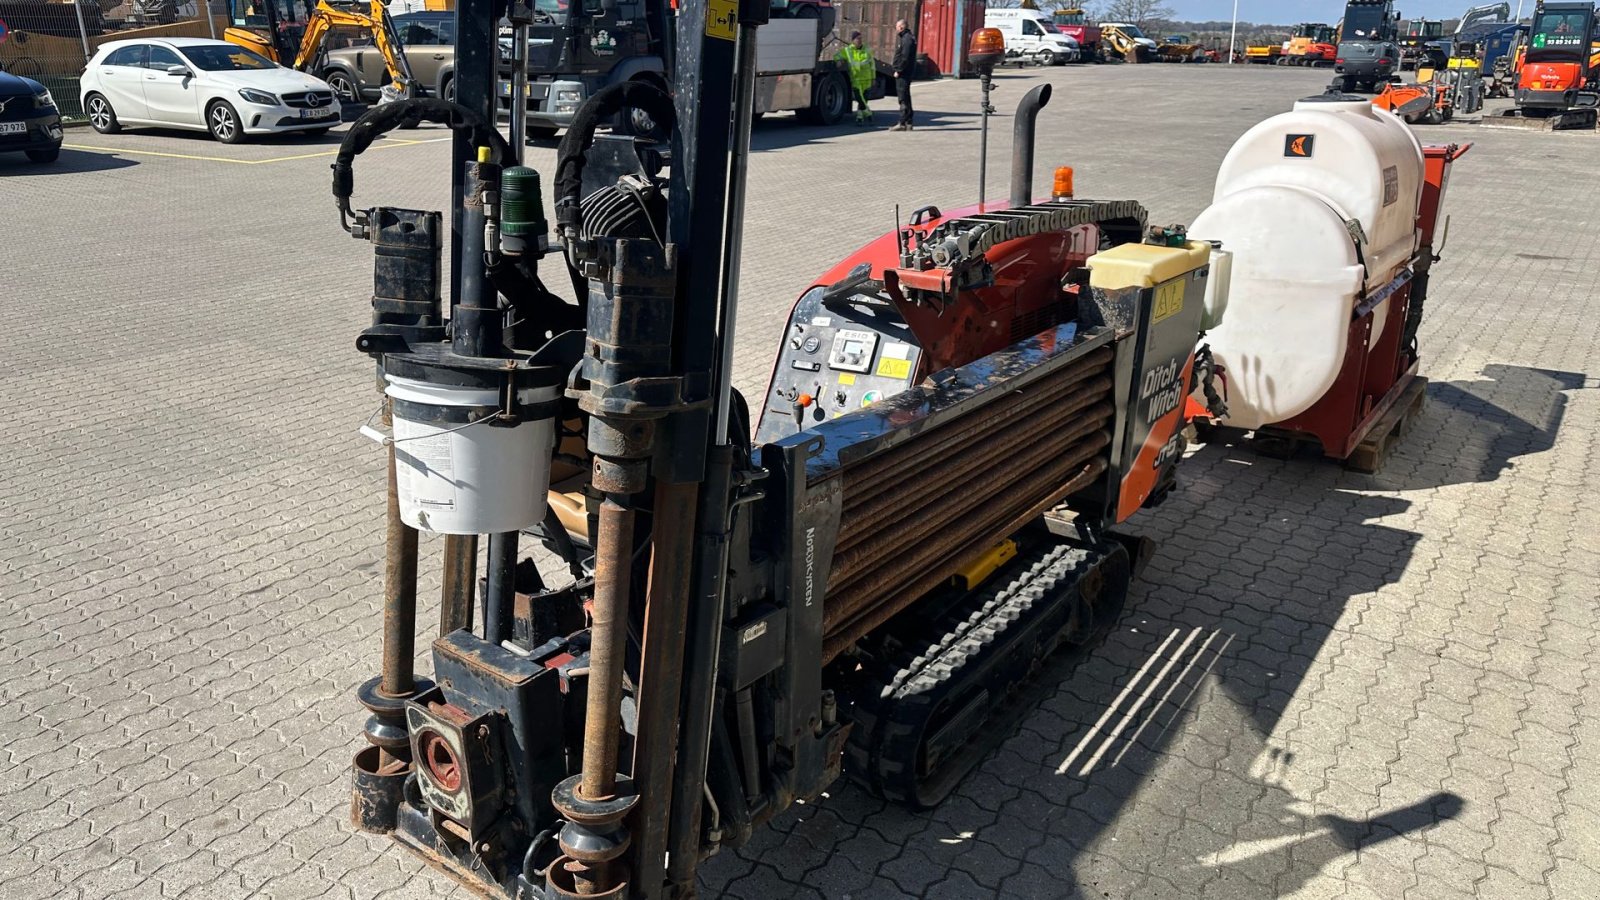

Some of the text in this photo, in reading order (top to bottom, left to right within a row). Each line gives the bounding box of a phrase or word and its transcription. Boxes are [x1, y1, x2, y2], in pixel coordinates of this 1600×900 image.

[10, 123, 26, 131] 978
[1142, 358, 1177, 400] Ditch
[1147, 383, 1182, 424] Witch
